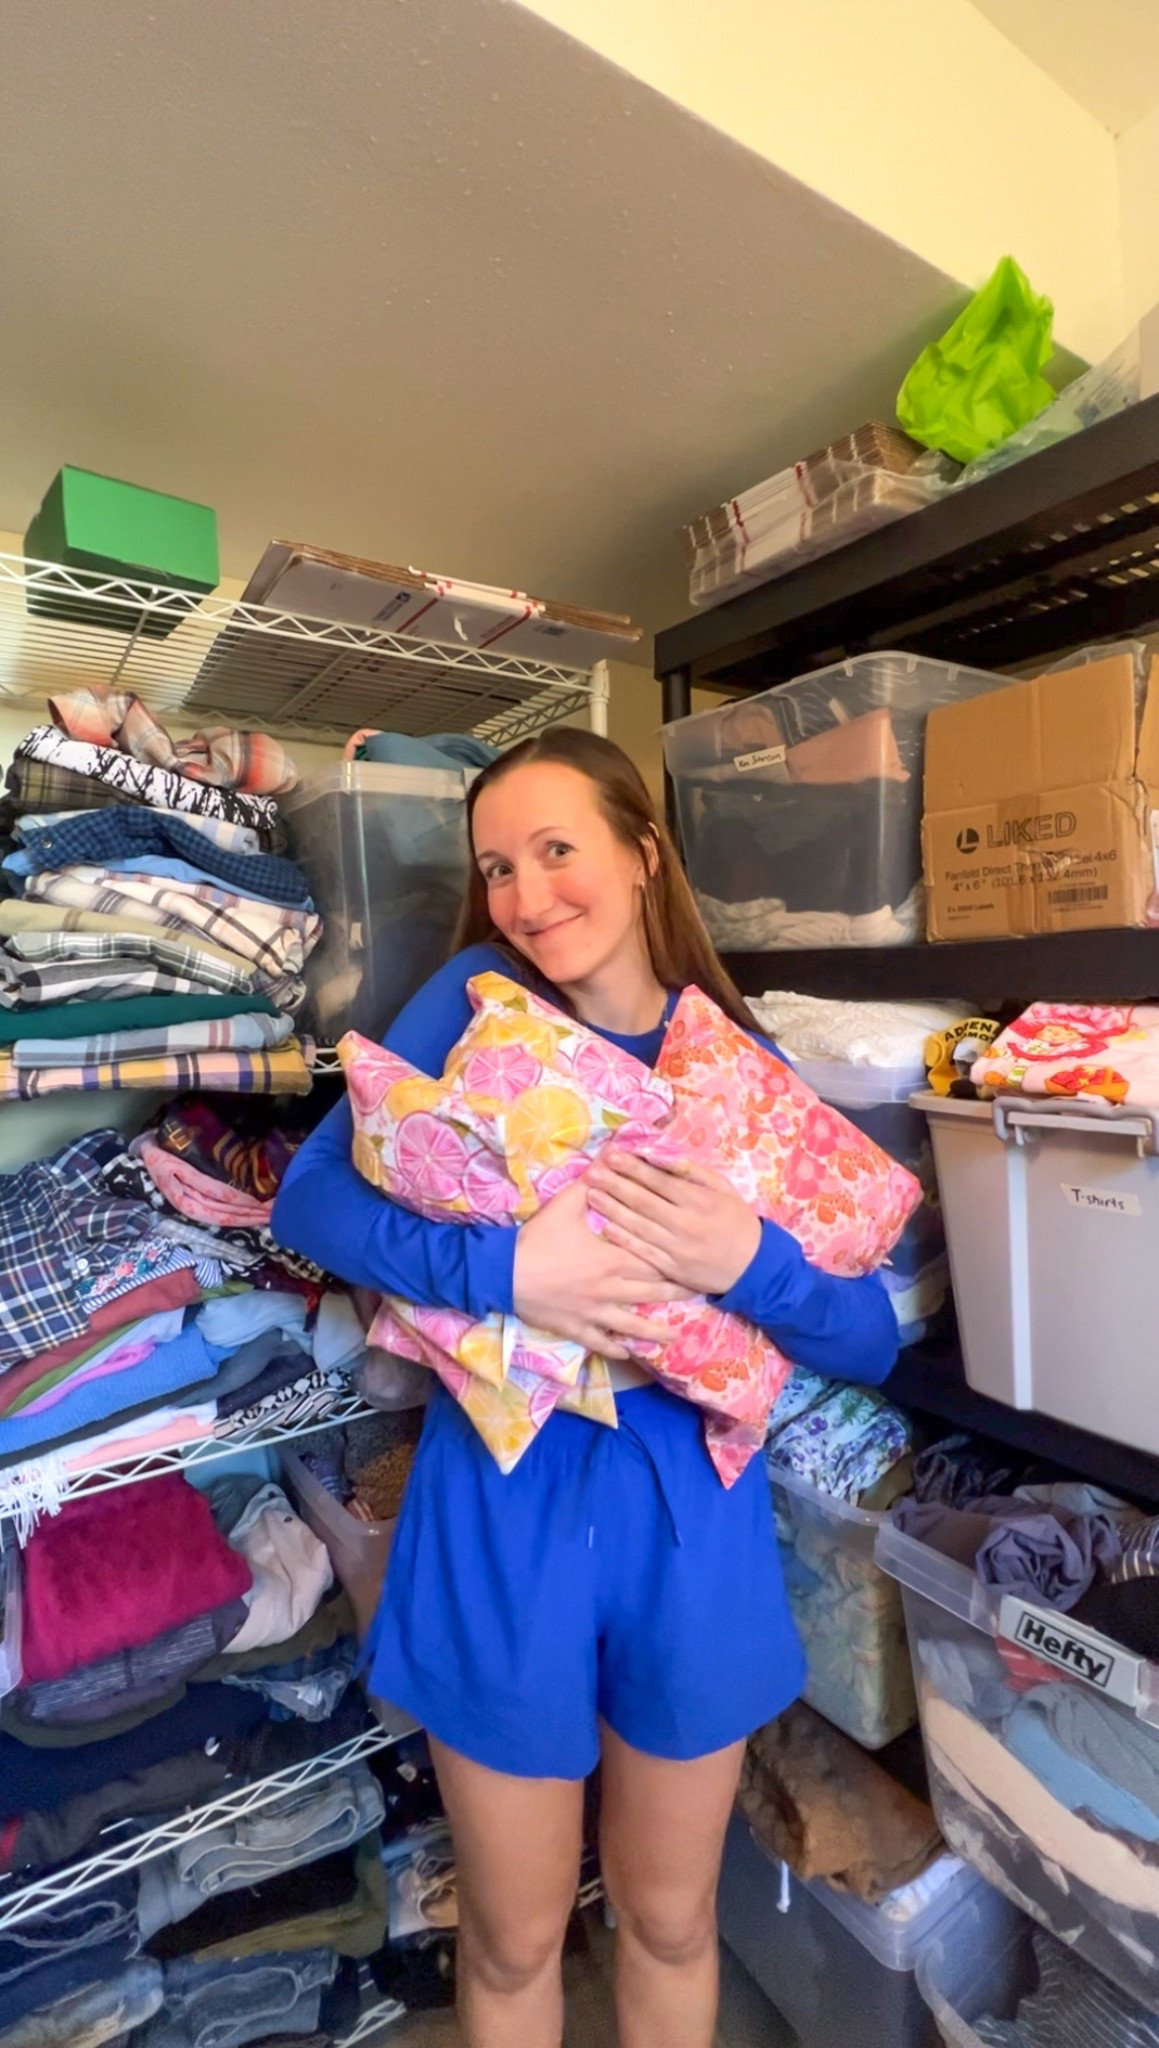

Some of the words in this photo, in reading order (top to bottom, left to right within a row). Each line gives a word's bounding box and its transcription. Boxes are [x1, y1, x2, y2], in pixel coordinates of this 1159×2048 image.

[986, 811, 1077, 849] LIKED
[945, 867, 980, 881] Fanfold
[983, 864, 1012, 877] Direct
[1094, 849, 1118, 863] 4x6
[1071, 1187, 1125, 1211] T-shirts
[1021, 1618, 1106, 1681] Hefty
